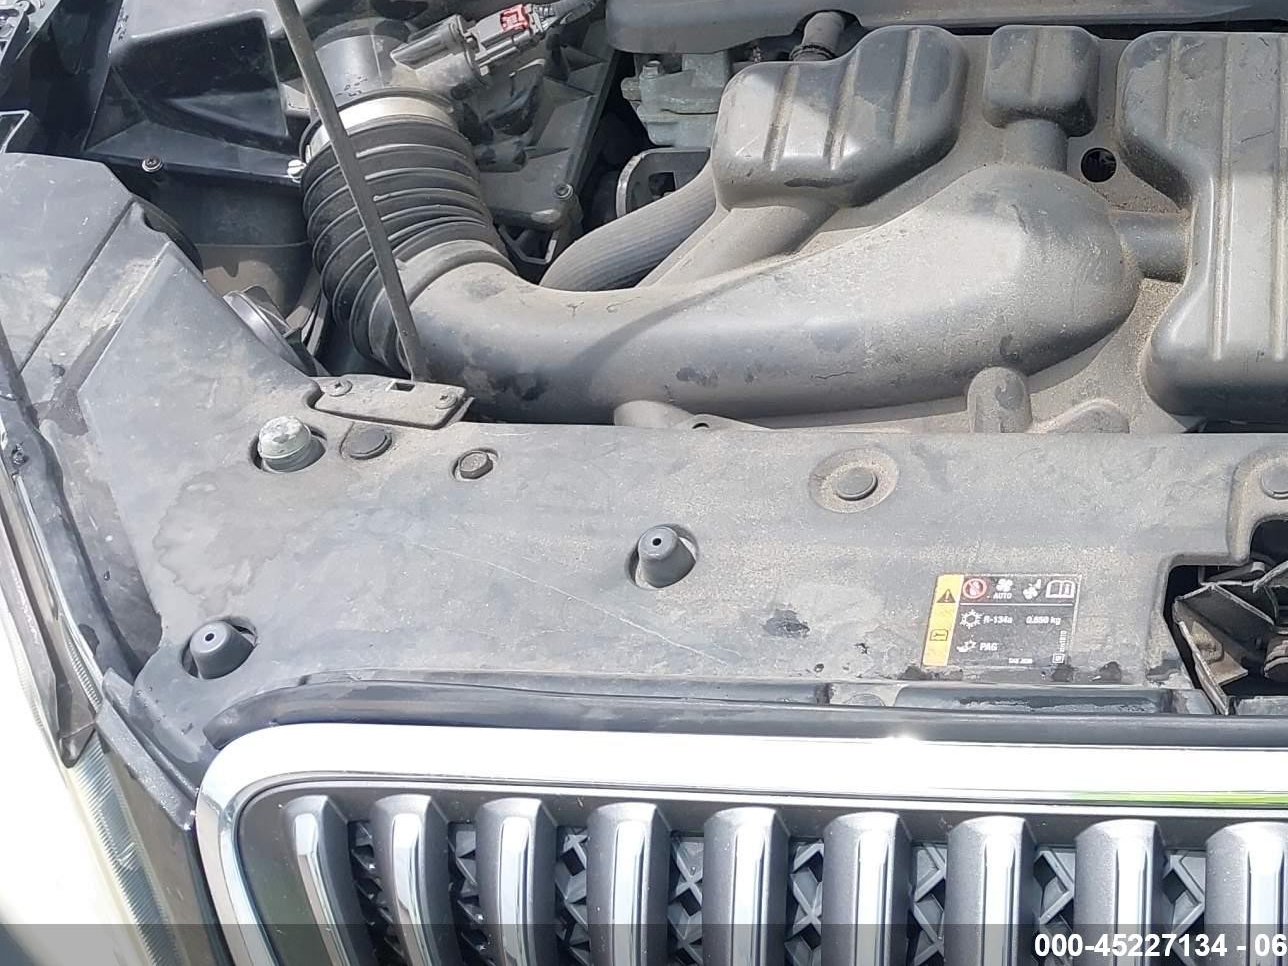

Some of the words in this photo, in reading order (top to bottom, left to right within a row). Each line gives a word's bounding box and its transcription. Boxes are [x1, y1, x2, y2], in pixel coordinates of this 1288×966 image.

[993, 592, 1013, 600] AUTO
[1050, 615, 1062, 626] kg
[979, 642, 998, 651] PAG
